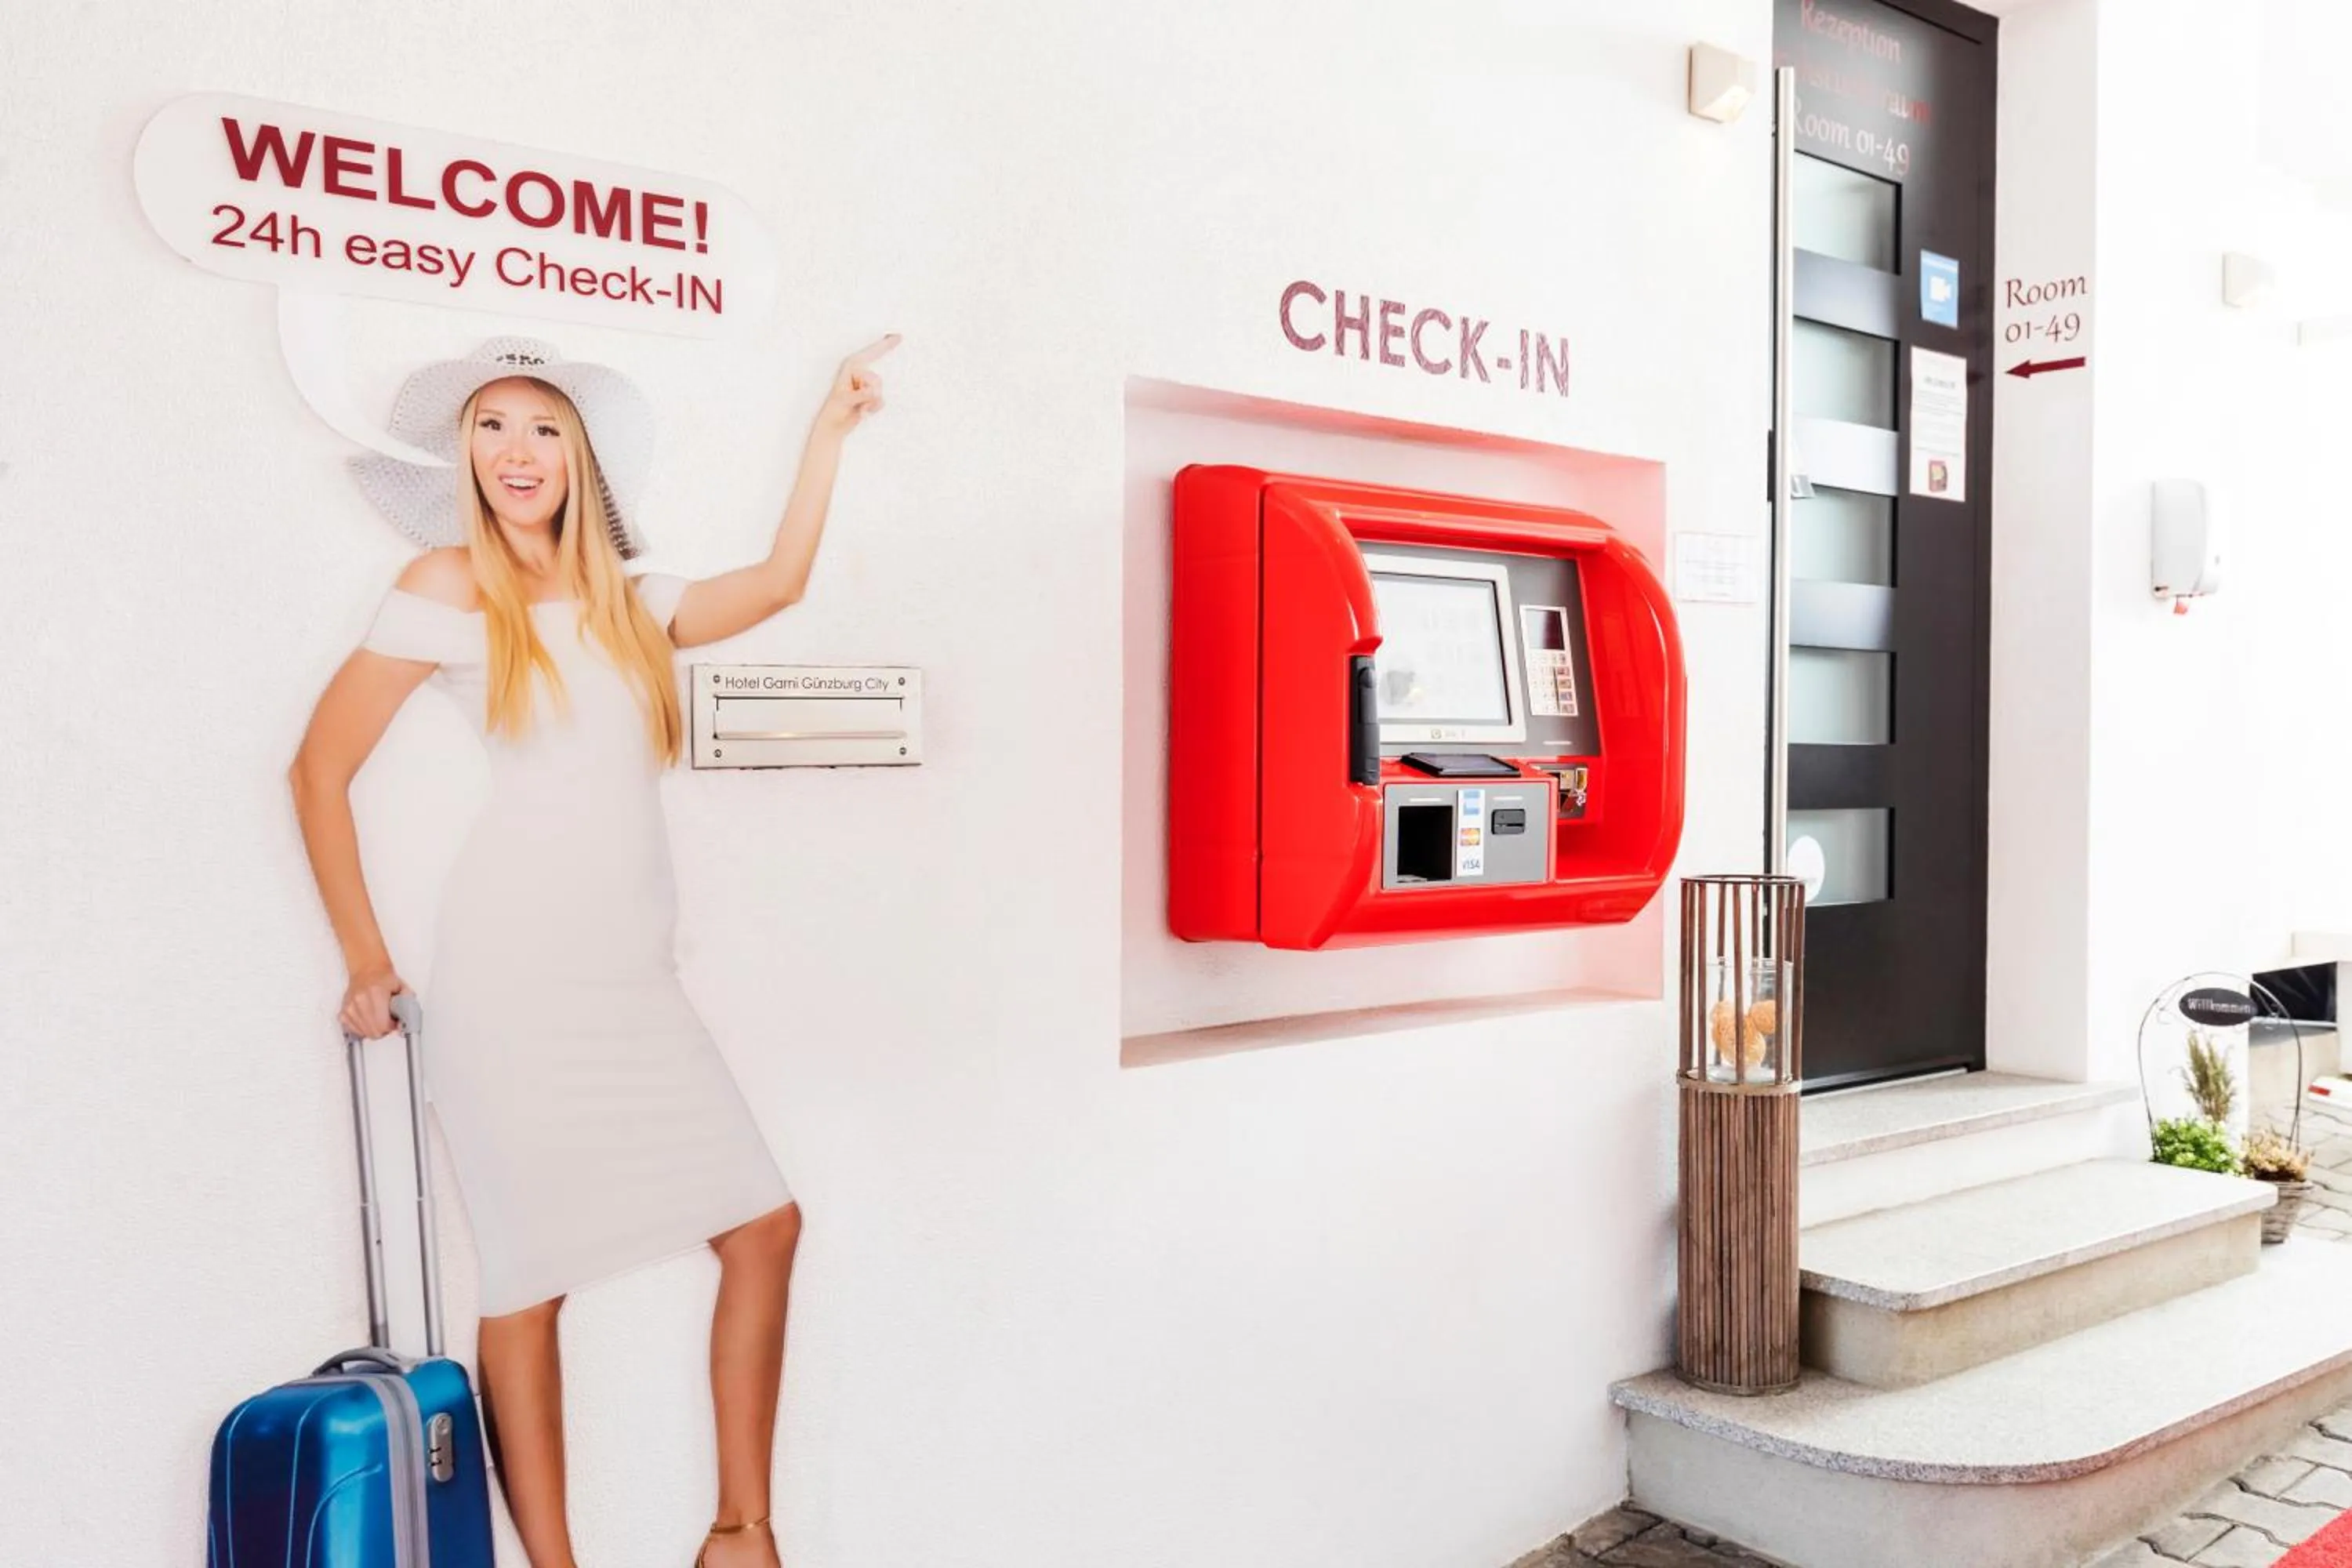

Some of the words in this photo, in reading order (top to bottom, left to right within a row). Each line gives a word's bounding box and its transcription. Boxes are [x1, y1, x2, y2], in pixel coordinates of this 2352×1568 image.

[1856, 129, 1911, 178] 01-49
[221, 117, 710, 254] WELCOME!
[211, 205, 322, 258] 24h
[345, 234, 476, 288] easy
[495, 247, 724, 314] Check-IN
[2005, 276, 2088, 308] Room
[1279, 280, 1569, 397] CHECK-IN
[2005, 313, 2082, 344] 01-49
[725, 677, 760, 689] Hotel
[763, 677, 799, 689] Garni
[801, 677, 862, 691] Günzburg
[865, 677, 889, 691] City
